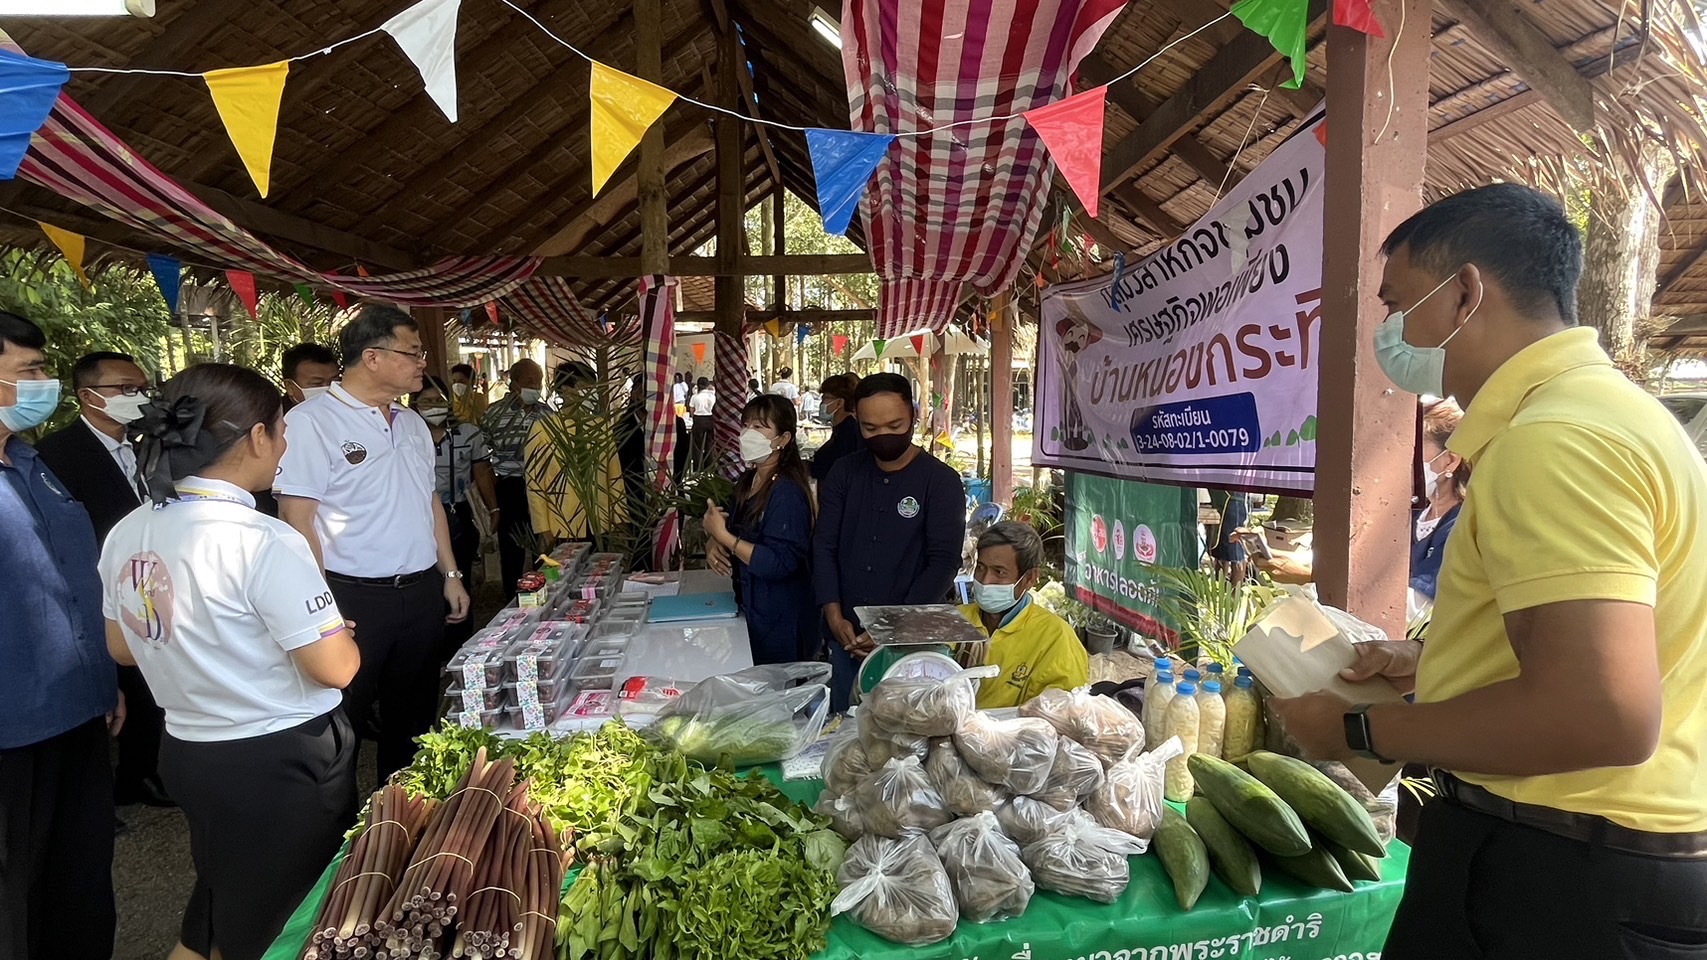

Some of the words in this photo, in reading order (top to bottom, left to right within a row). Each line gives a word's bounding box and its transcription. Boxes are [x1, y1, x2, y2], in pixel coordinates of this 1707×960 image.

[1123, 244, 1289, 347] เศรษฐกิจพอเพียง
[1152, 406, 1211, 429] รหัสทะเบียน
[1136, 428, 1249, 449] 3-24-08-02/1-0079
[306, 591, 332, 615] LDD
